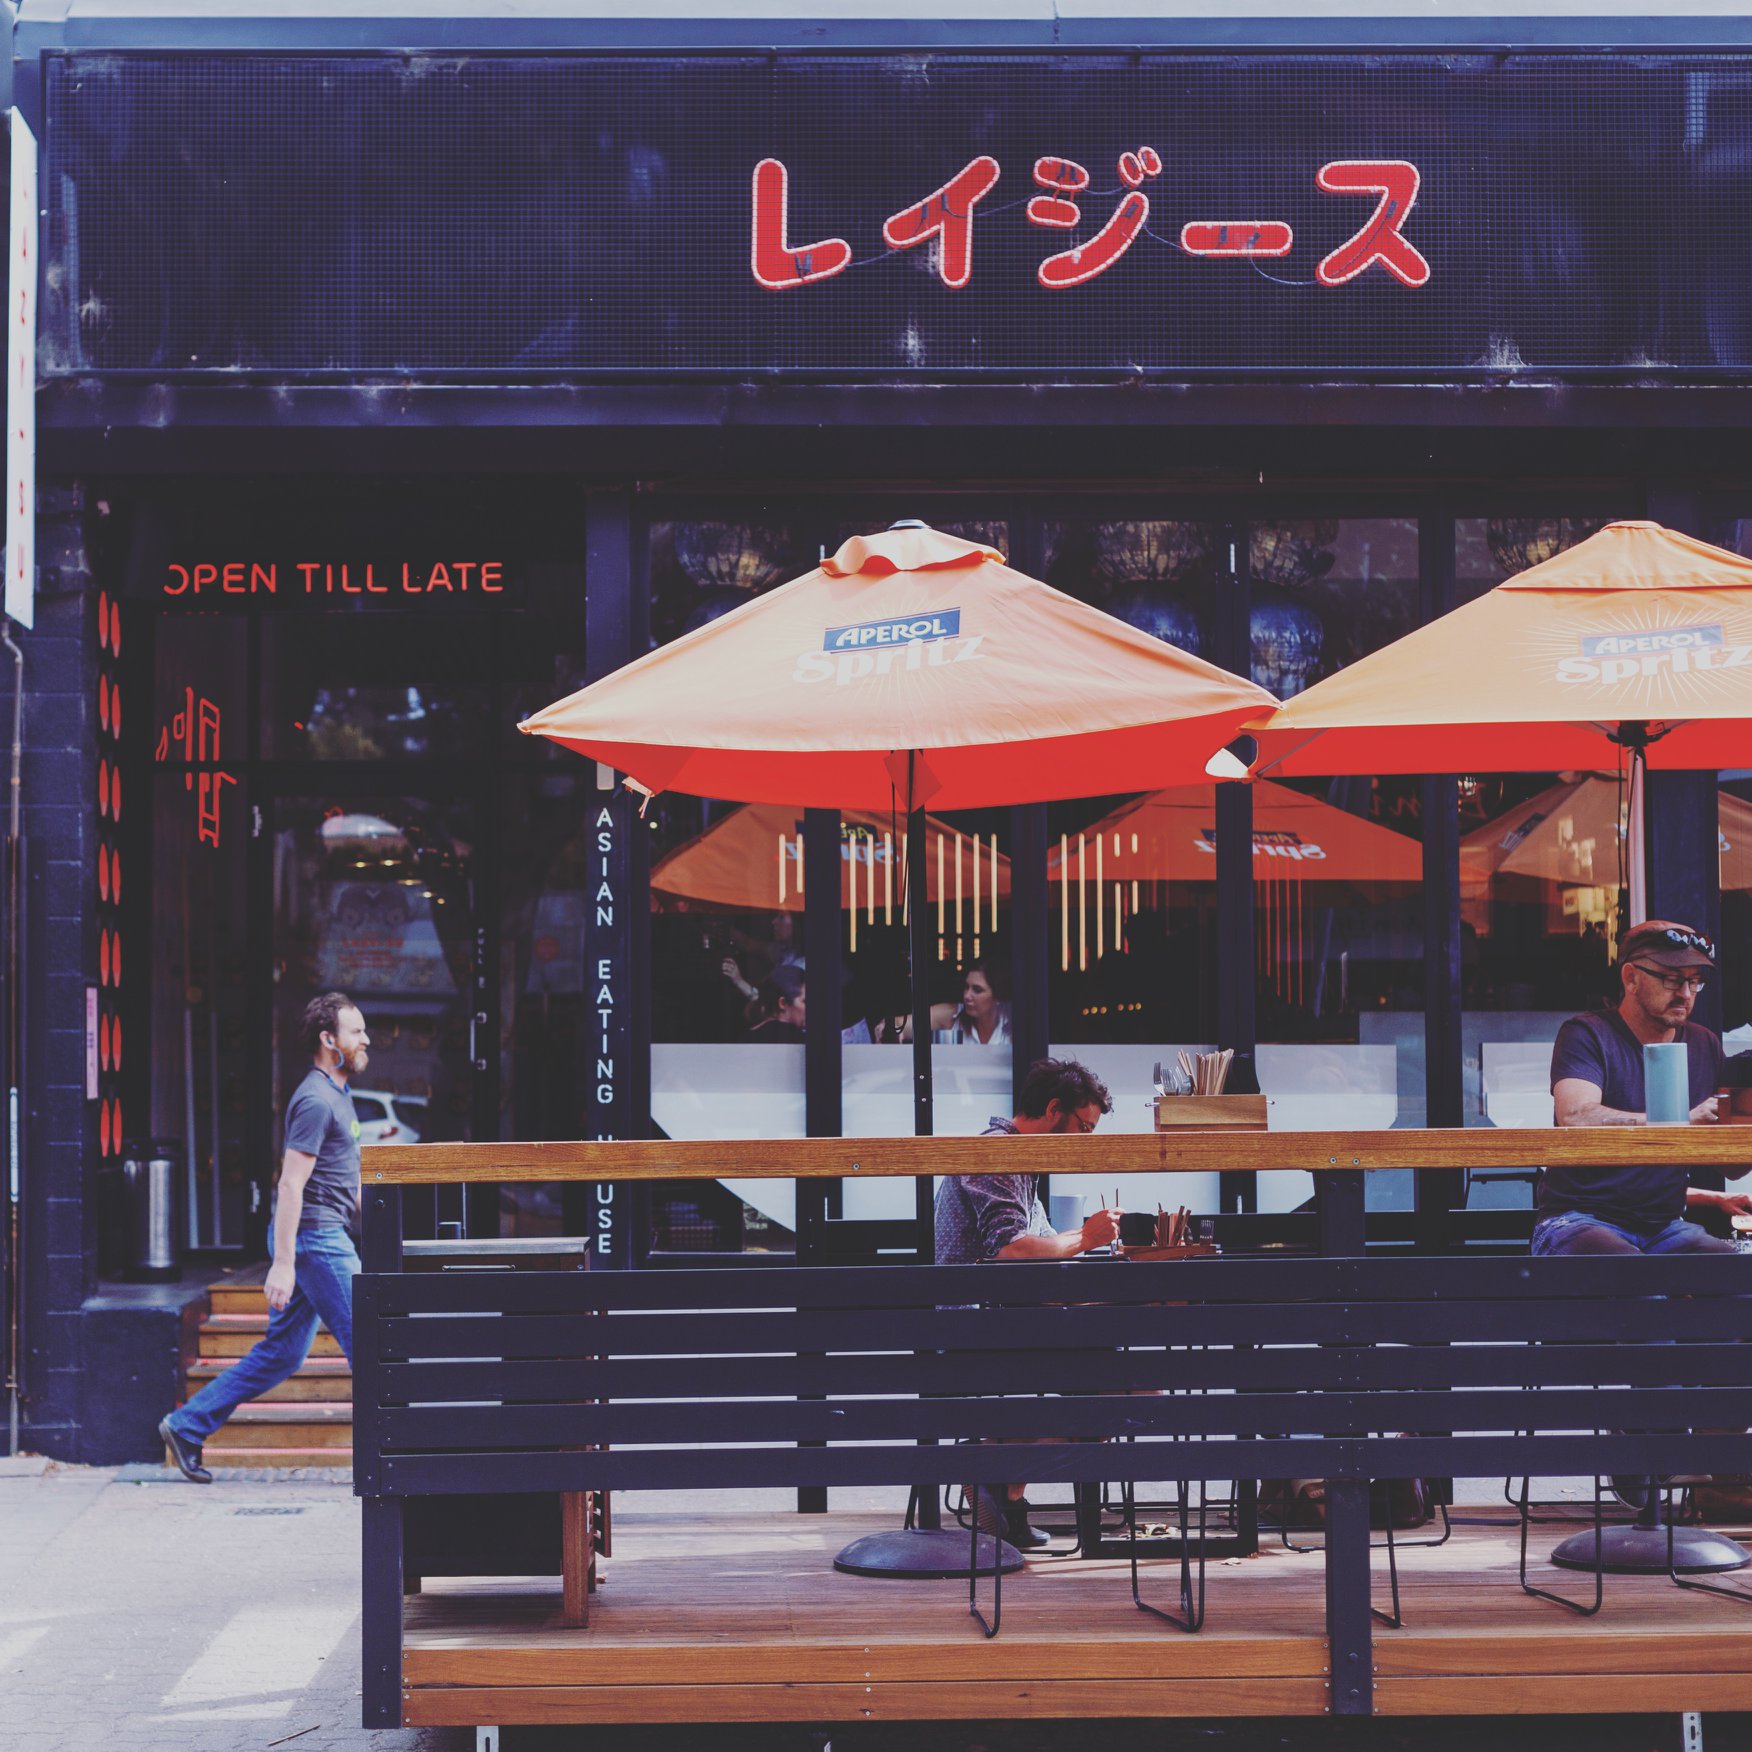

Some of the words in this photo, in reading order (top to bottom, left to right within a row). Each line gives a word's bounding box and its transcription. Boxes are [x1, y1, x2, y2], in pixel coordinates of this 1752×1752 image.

[751, 146, 1431, 289] レイジース
[163, 563, 277, 595] OPEN
[296, 563, 388, 593] TILL
[402, 562, 504, 593] LATE
[835, 618, 947, 647] APEROL
[1594, 631, 1712, 655] APEROL
[792, 634, 986, 686] Spritz
[1555, 645, 1752, 685] Spritz
[596, 807, 614, 927] ASIAN
[596, 959, 614, 1104] EATING
[596, 1134, 614, 1254] USE
